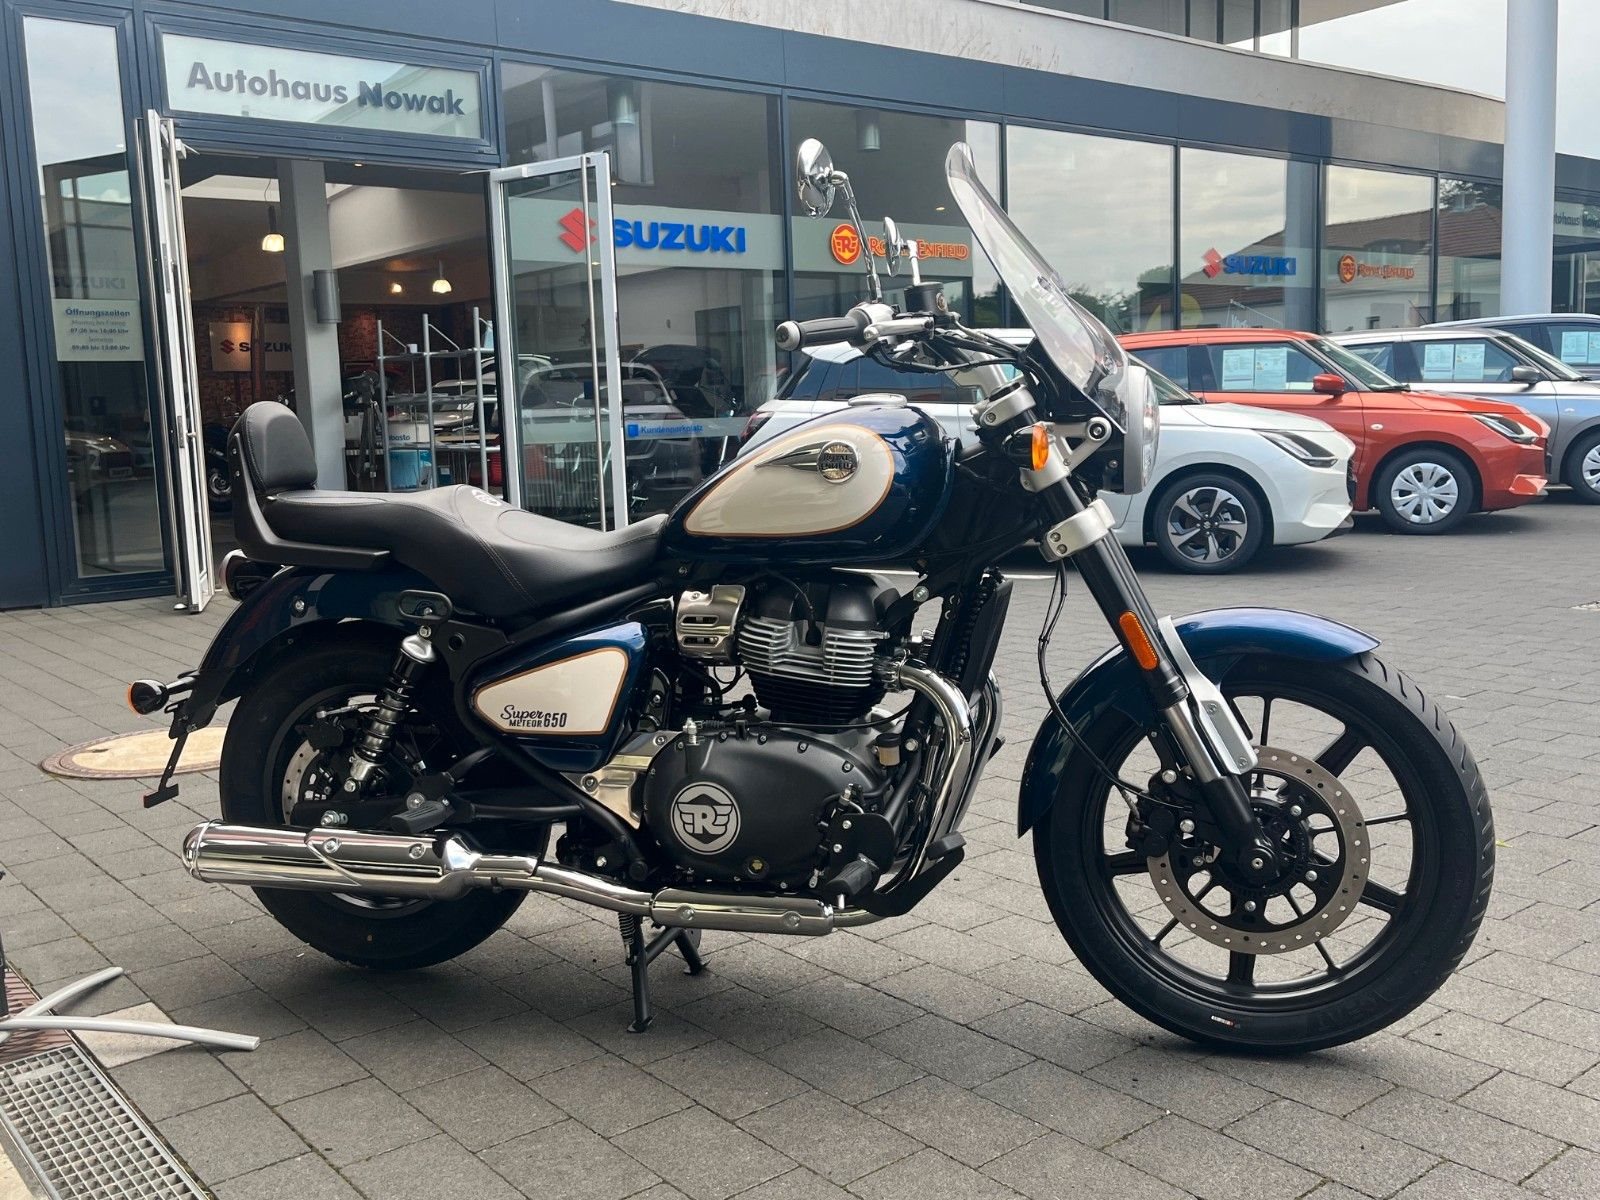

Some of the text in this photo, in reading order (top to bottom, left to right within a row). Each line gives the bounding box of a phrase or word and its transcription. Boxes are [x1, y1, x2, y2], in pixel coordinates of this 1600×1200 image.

[187, 61, 465, 115] Autohaus Nowak
[613, 218, 746, 252] SUZUKI
[1223, 256, 1297, 275] SUZUKI
[65, 307, 131, 318] Öffnungszeiten
[500, 704, 545, 722] Super
[508, 712, 568, 728] METEOR 650
